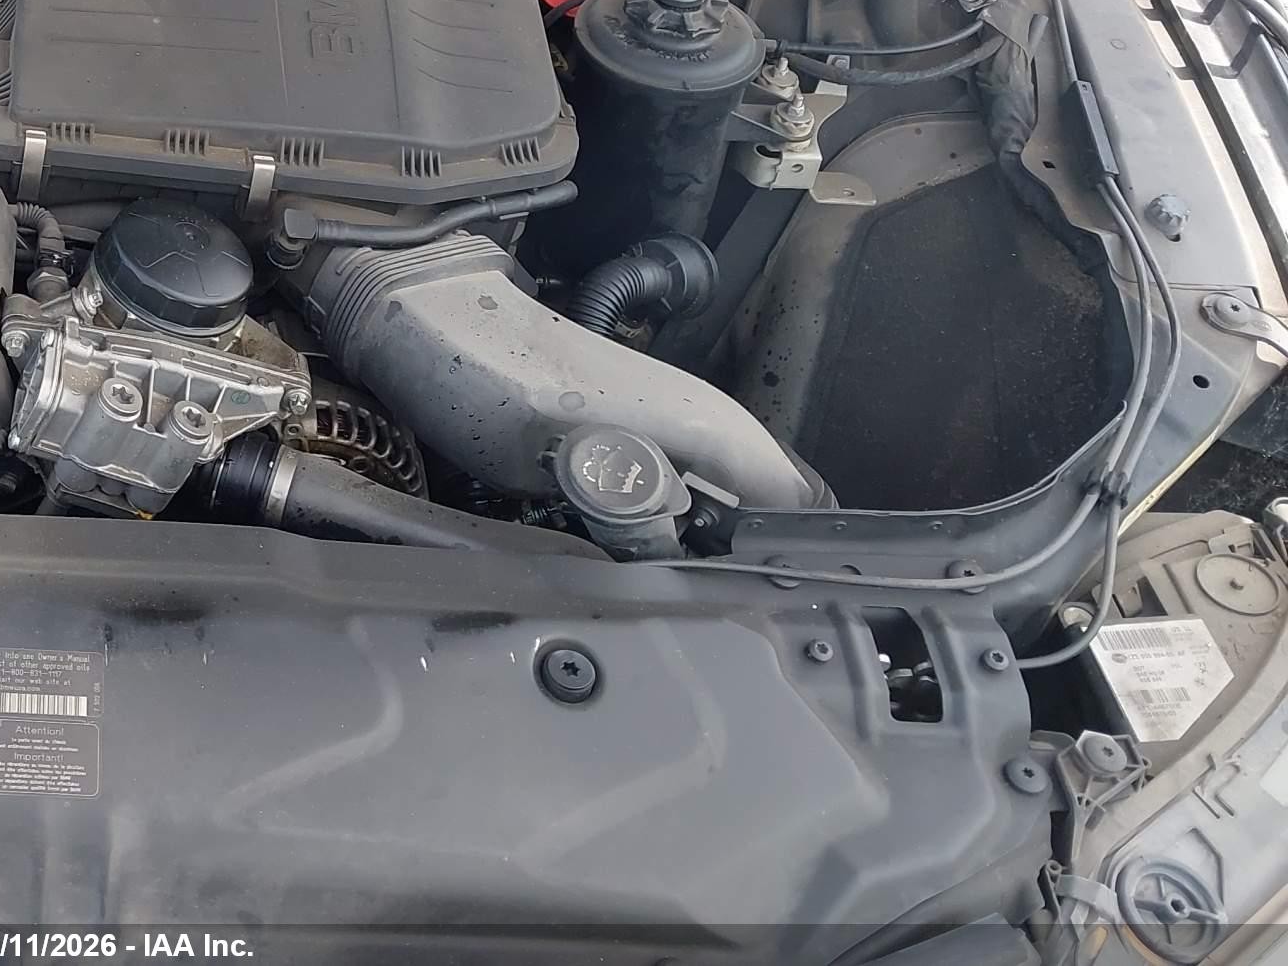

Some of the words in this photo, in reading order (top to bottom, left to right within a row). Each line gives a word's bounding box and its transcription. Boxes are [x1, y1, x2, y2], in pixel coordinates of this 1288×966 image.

[67, 654, 90, 662] Manual
[42, 663, 74, 671] approved
[15, 726, 64, 736] Attention!
[14, 752, 64, 762] Important!
